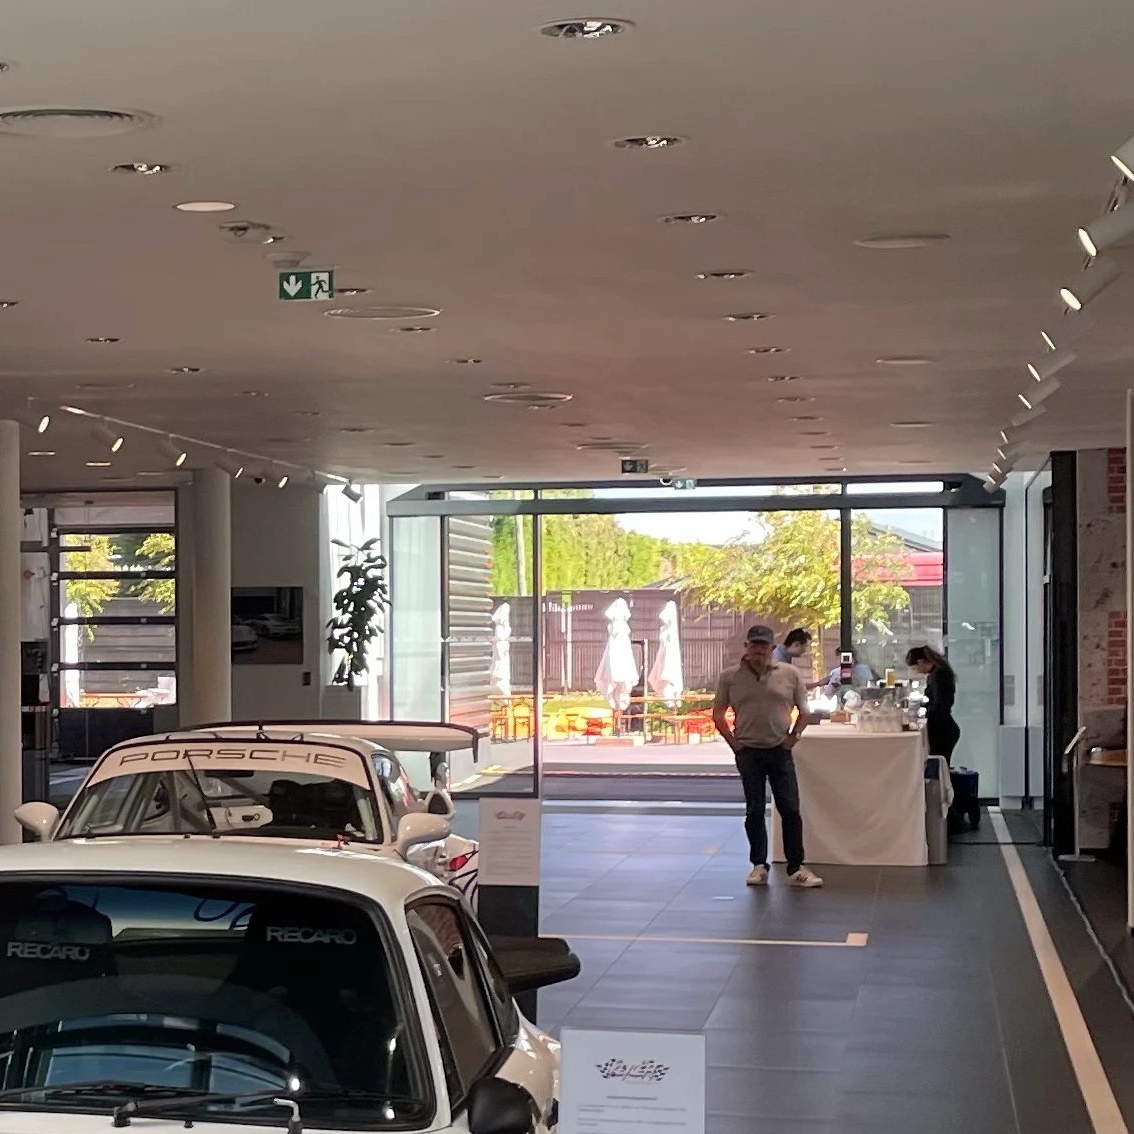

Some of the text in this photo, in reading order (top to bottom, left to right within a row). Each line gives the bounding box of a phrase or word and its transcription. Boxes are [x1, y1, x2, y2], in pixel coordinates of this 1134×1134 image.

[119, 748, 346, 768] PORSCHE
[266, 926, 357, 945] RECARO
[7, 941, 90, 961] RECARO
